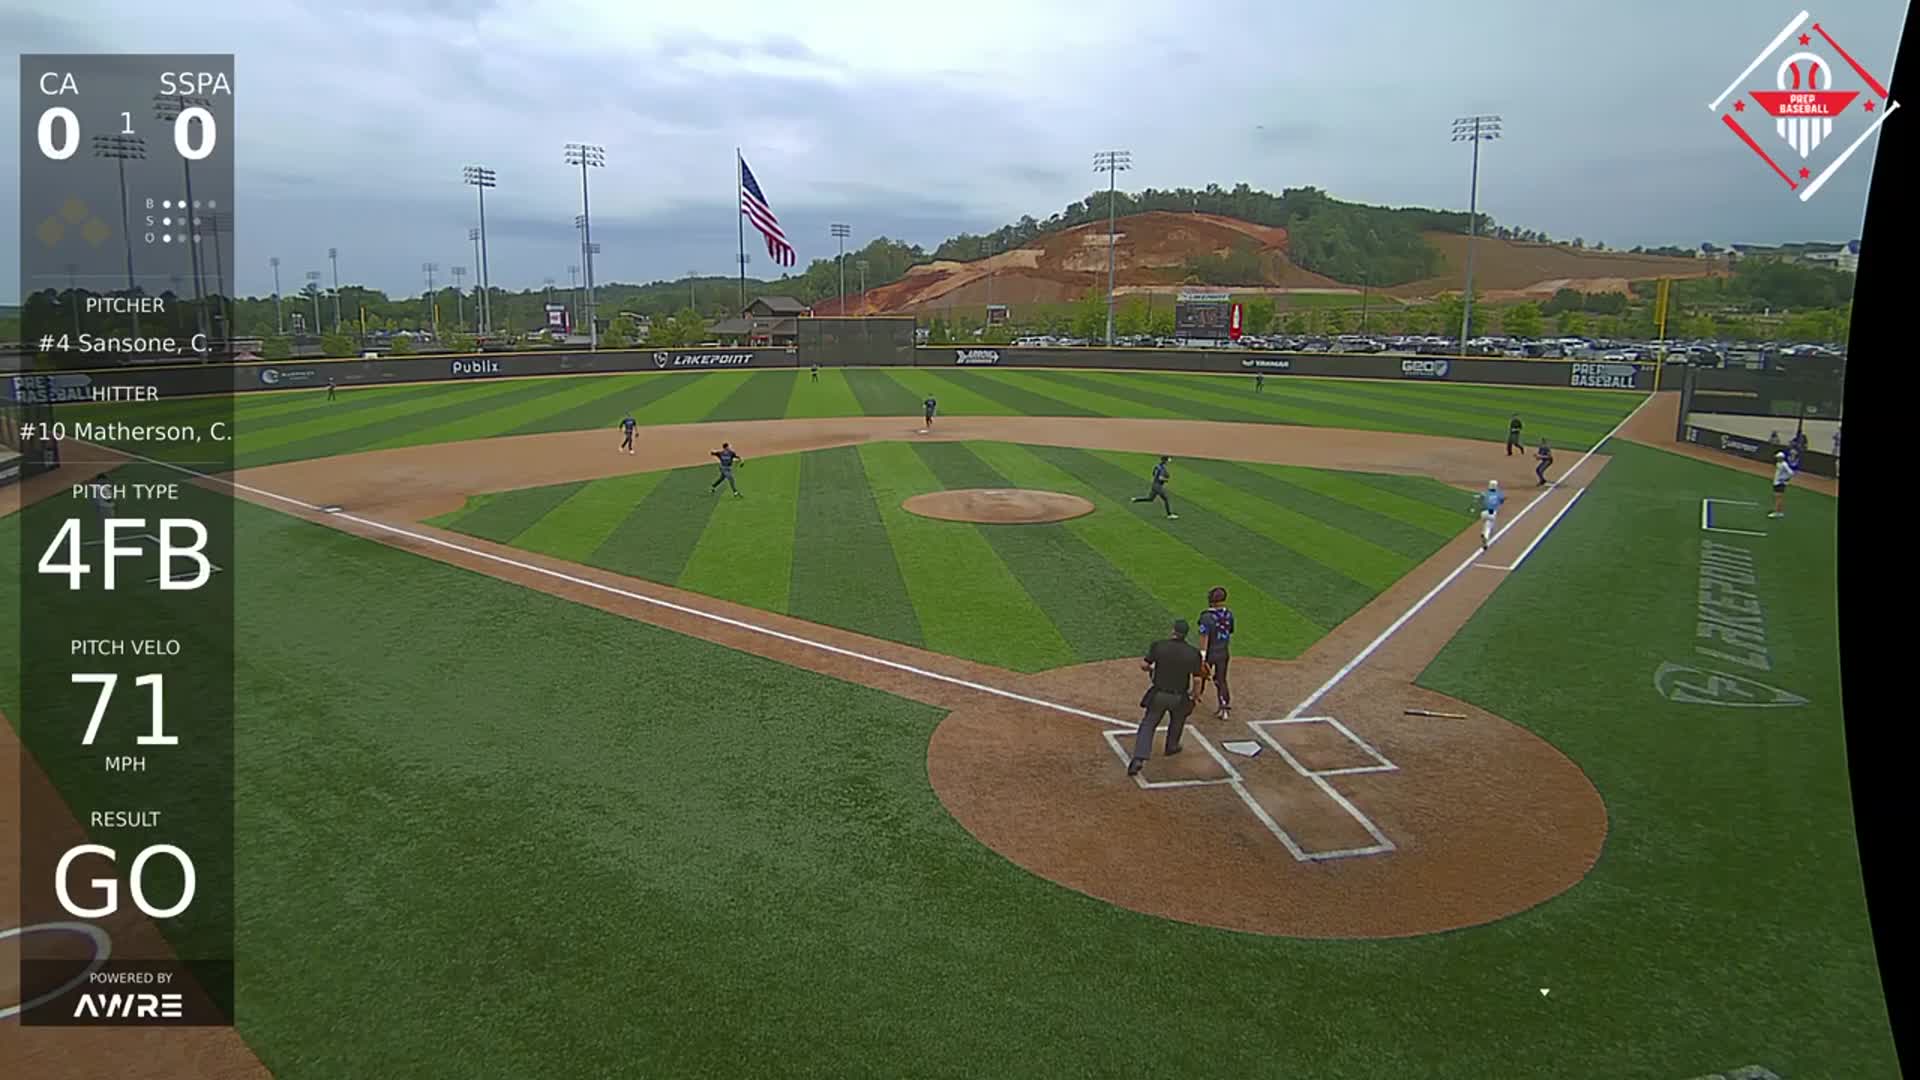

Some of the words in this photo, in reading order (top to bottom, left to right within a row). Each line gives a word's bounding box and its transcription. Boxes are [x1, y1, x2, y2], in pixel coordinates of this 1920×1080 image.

[674, 354, 753, 365] LAKEPOINT
[453, 360, 499, 374] Publix
[1571, 374, 1636, 388] BASEBALL
[1695, 540, 1771, 671] LAKEPOINT
